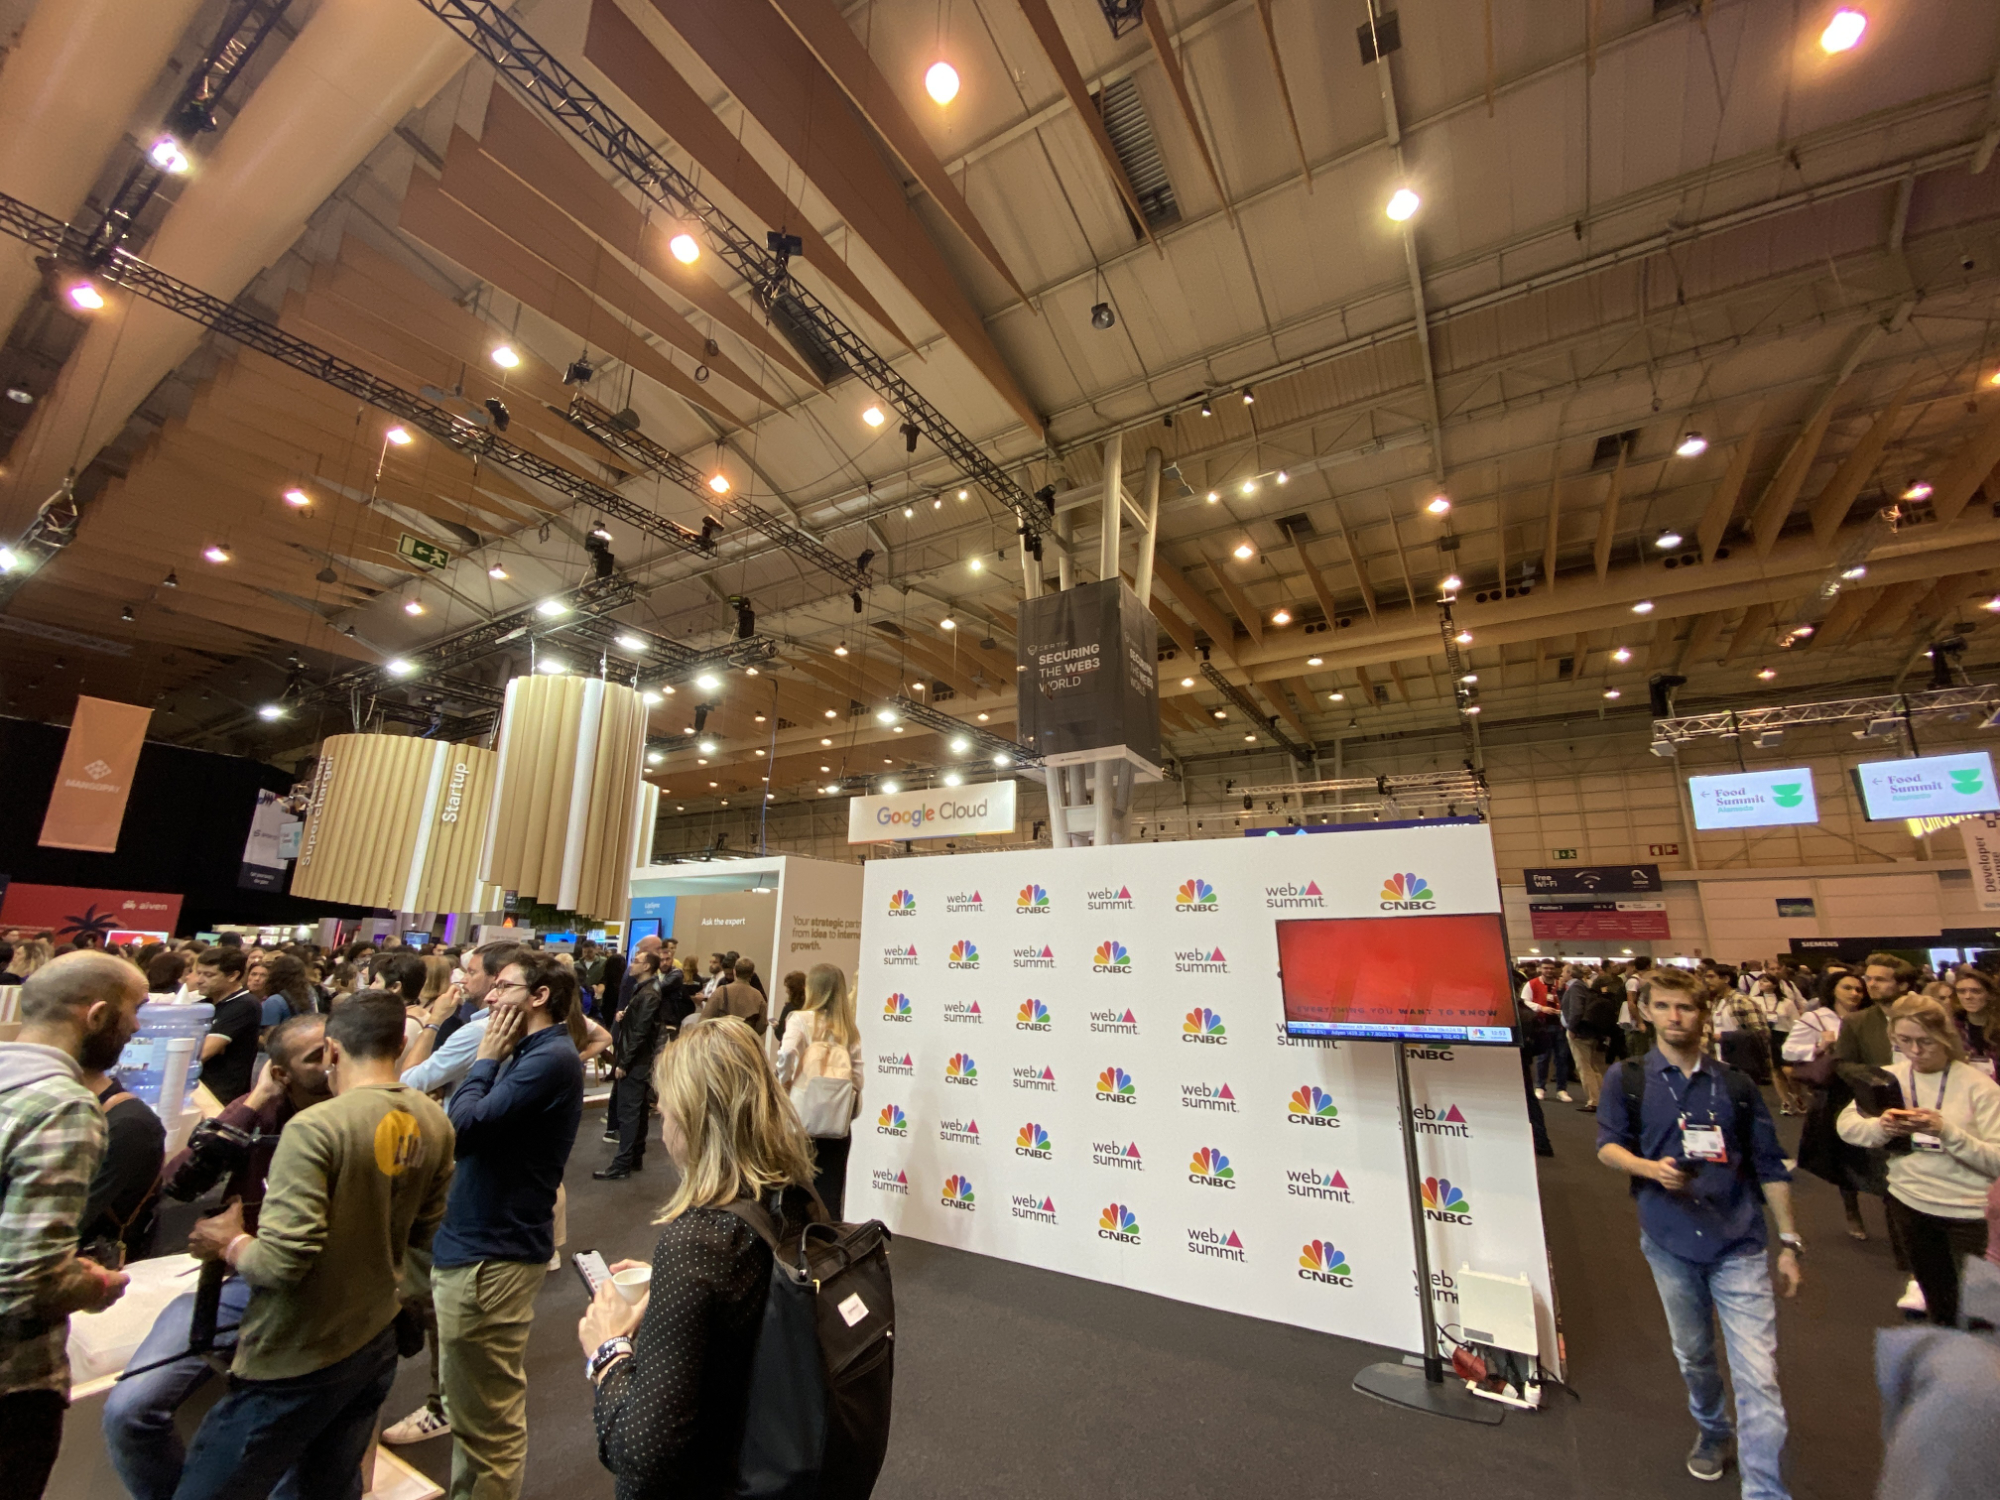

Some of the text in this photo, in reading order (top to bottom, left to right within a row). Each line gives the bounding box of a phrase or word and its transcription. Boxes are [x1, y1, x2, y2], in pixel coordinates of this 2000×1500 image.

[1039, 644, 1100, 665] SECURING
[1039, 658, 1100, 678] THE WEB3
[1039, 676, 1081, 693] WORLD
[1888, 774, 1922, 785] Food
[441, 762, 470, 823] Startup
[1715, 788, 1746, 798] Food
[1890, 782, 1943, 794] Summit
[1716, 795, 1765, 806] Summit
[301, 754, 334, 867] Supercharger
[877, 799, 988, 828] Google Cloud
[1718, 806, 1754, 814] Alameda
[1975, 836, 1997, 893] Developer
[1087, 887, 1113, 900] web
[1265, 883, 1298, 897] web
[947, 892, 967, 903] web
[1266, 895, 1325, 908] summit
[139, 902, 168, 911] aiven
[947, 903, 984, 913] summit
[1016, 906, 1051, 914] CNBC
[1088, 899, 1133, 910] summit
[1175, 904, 1220, 913] CNBC
[1380, 901, 1437, 911] CNBC
[701, 916, 746, 928] Ask the expert
[793, 915, 810, 926] Your
[811, 918, 844, 930] strategic
[792, 928, 810, 938] from
[811, 928, 828, 939] idea
[829, 930, 837, 939] to
[791, 941, 822, 953] growth.
[884, 945, 904, 956] web
[1014, 946, 1037, 958] web
[884, 956, 918, 966] summit
[1175, 948, 1204, 962] web
[948, 962, 980, 970] CNBC
[1014, 957, 1055, 969] summit
[1093, 965, 1133, 974] CNBC
[1175, 961, 1228, 974] summit
[944, 1002, 966, 1013] web
[1296, 1006, 1365, 1014] EVERYTHING
[1459, 1009, 1498, 1017] KNOW
[883, 1014, 913, 1023] CNBC
[944, 1013, 983, 1024] summit
[1090, 1009, 1117, 1022] web
[1016, 1022, 1052, 1032] CNBC
[1091, 1022, 1138, 1035] summit
[1182, 1034, 1228, 1046] CNBC
[879, 1053, 898, 1065] web
[878, 1064, 914, 1077] summit
[1013, 1066, 1037, 1079] web
[945, 1076, 979, 1087] CNBC
[1013, 1078, 1056, 1092] summit
[1181, 1083, 1212, 1097] web
[1096, 1092, 1137, 1105] CNBC
[1182, 1097, 1237, 1113] summit
[1397, 1103, 1436, 1121] eb
[940, 1119, 963, 1132] web
[1288, 1114, 1341, 1128] CNBC
[877, 1126, 908, 1138] CNBC
[1399, 1121, 1469, 1138] mmit
[940, 1131, 981, 1146] summit
[1015, 1147, 1053, 1161] CNBC
[1093, 1141, 1121, 1155] web
[1093, 1154, 1143, 1172] summit
[873, 1169, 893, 1181] web
[1287, 1169, 1322, 1186] web
[872, 1180, 909, 1196] summit
[1189, 1174, 1237, 1190] CNBC
[1288, 1184, 1352, 1204] summit
[941, 1198, 976, 1212] CNBC
[1012, 1194, 1037, 1209] web
[1012, 1208, 1057, 1225] summit
[1423, 1210, 1473, 1226] NBC
[1098, 1229, 1142, 1246] CNBC
[1188, 1228, 1219, 1244] web
[1188, 1242, 1246, 1263] summit
[1298, 1269, 1354, 1288] CNBC
[1412, 1270, 1454, 1288] eb
